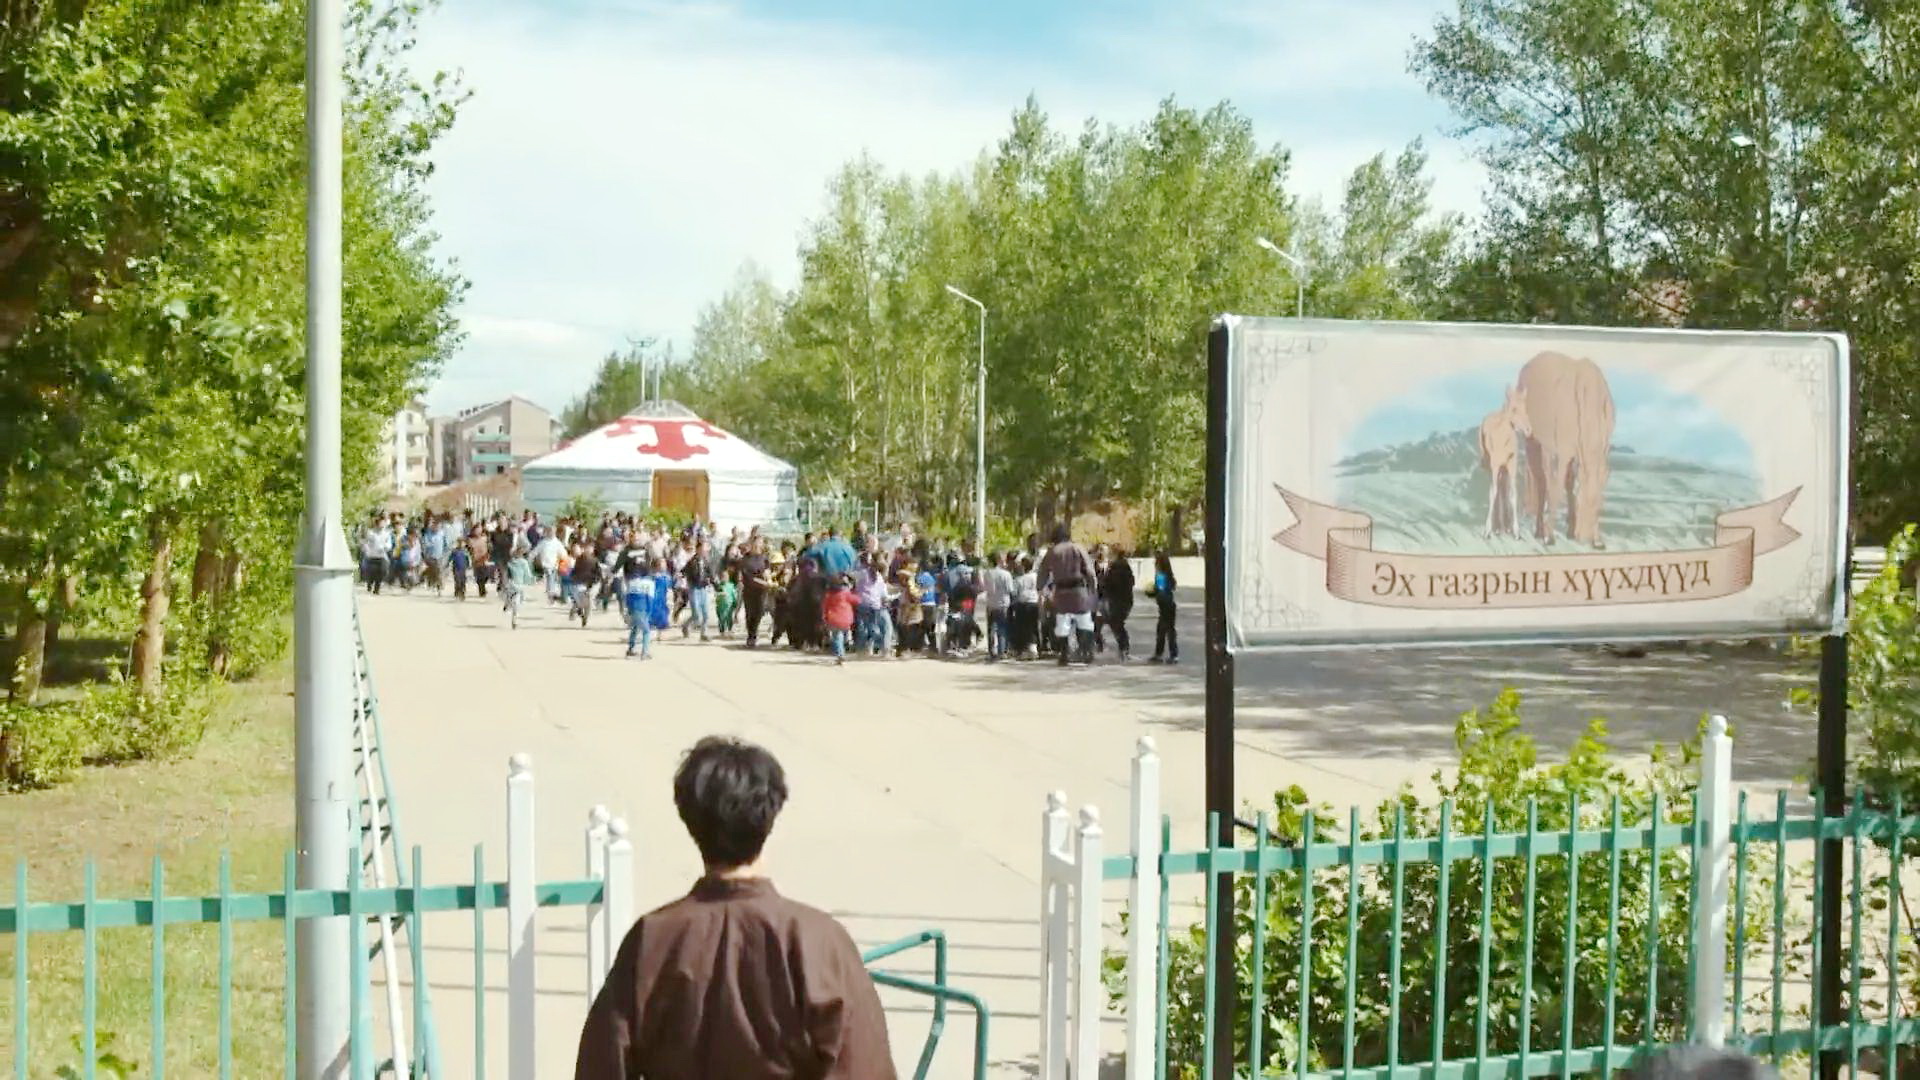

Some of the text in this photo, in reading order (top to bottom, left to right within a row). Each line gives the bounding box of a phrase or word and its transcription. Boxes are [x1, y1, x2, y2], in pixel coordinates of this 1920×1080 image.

[1372, 560, 1711, 603] Эх газрын хүүхдүүд
